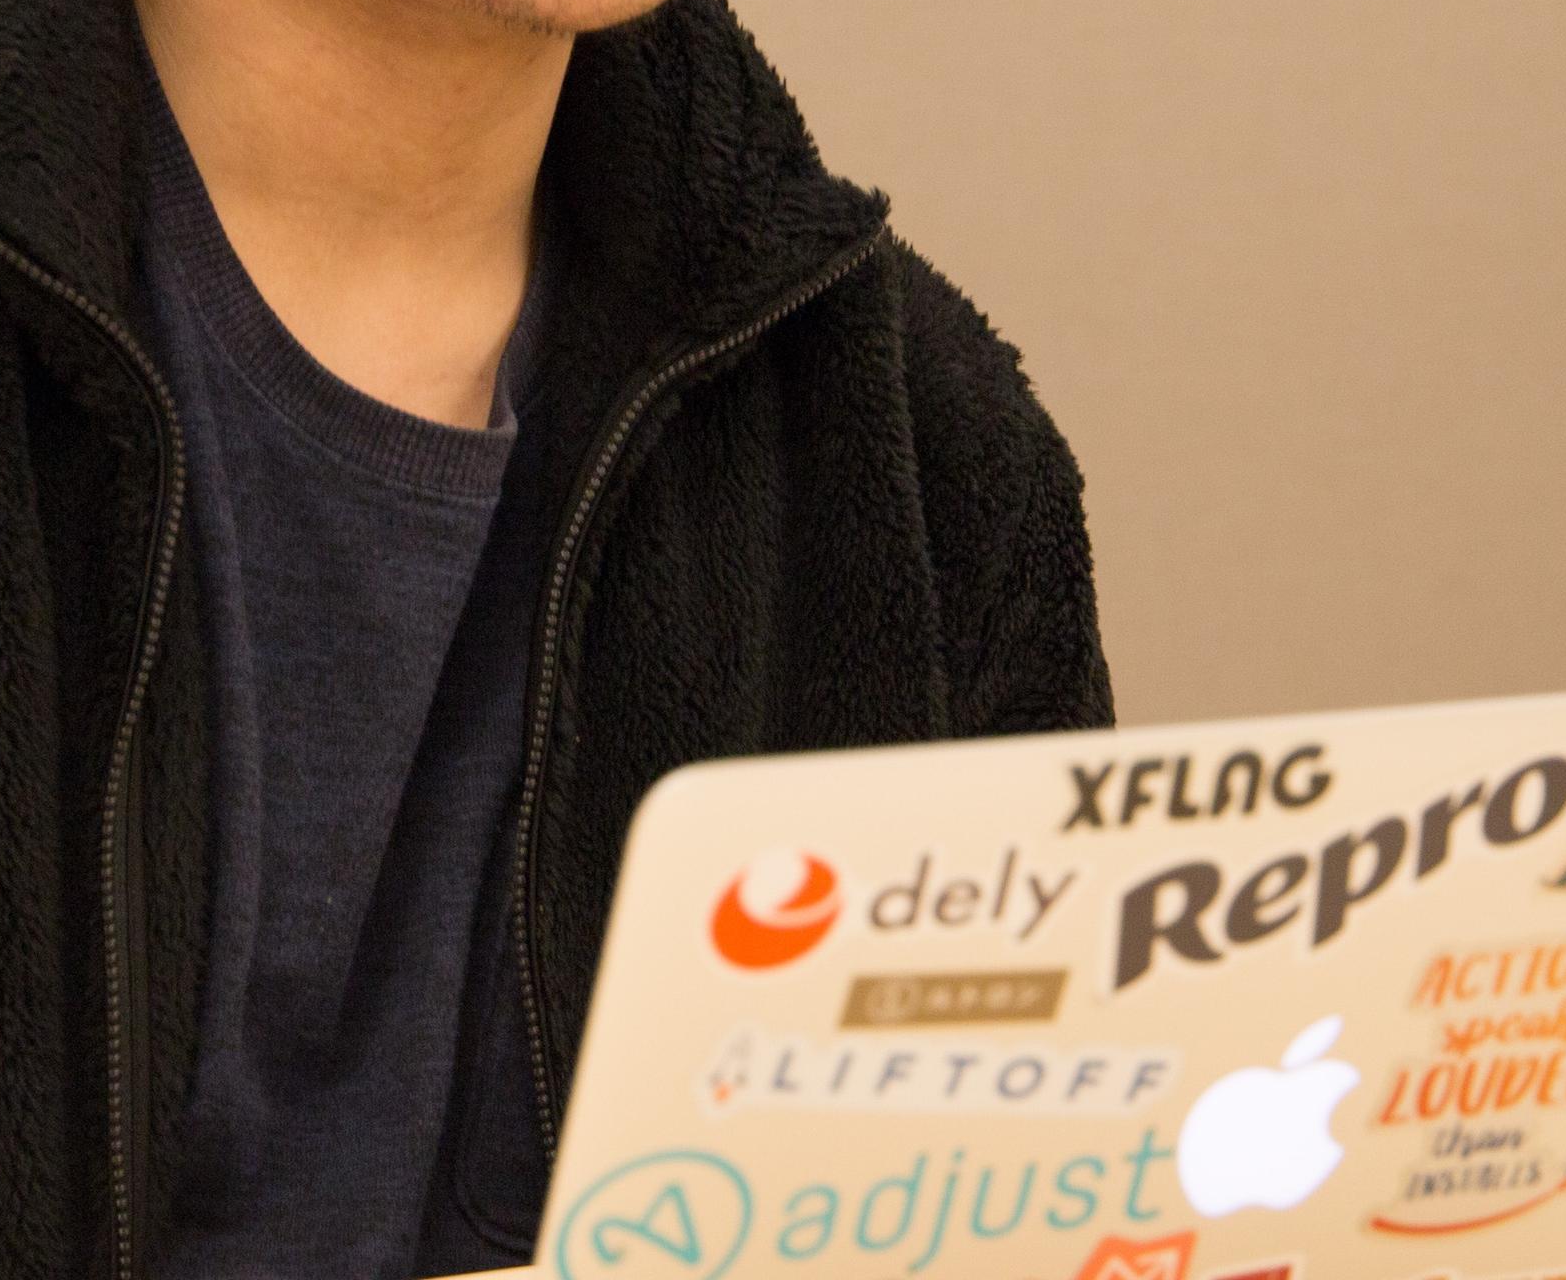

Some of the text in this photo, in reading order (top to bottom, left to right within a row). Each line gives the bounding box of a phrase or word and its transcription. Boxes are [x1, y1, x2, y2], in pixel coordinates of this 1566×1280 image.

[1061, 744, 1333, 833] XFLAG
[869, 845, 1078, 944] dely
[770, 1047, 1169, 1104] LIFTOFF
[775, 1127, 1175, 1274] adjust
